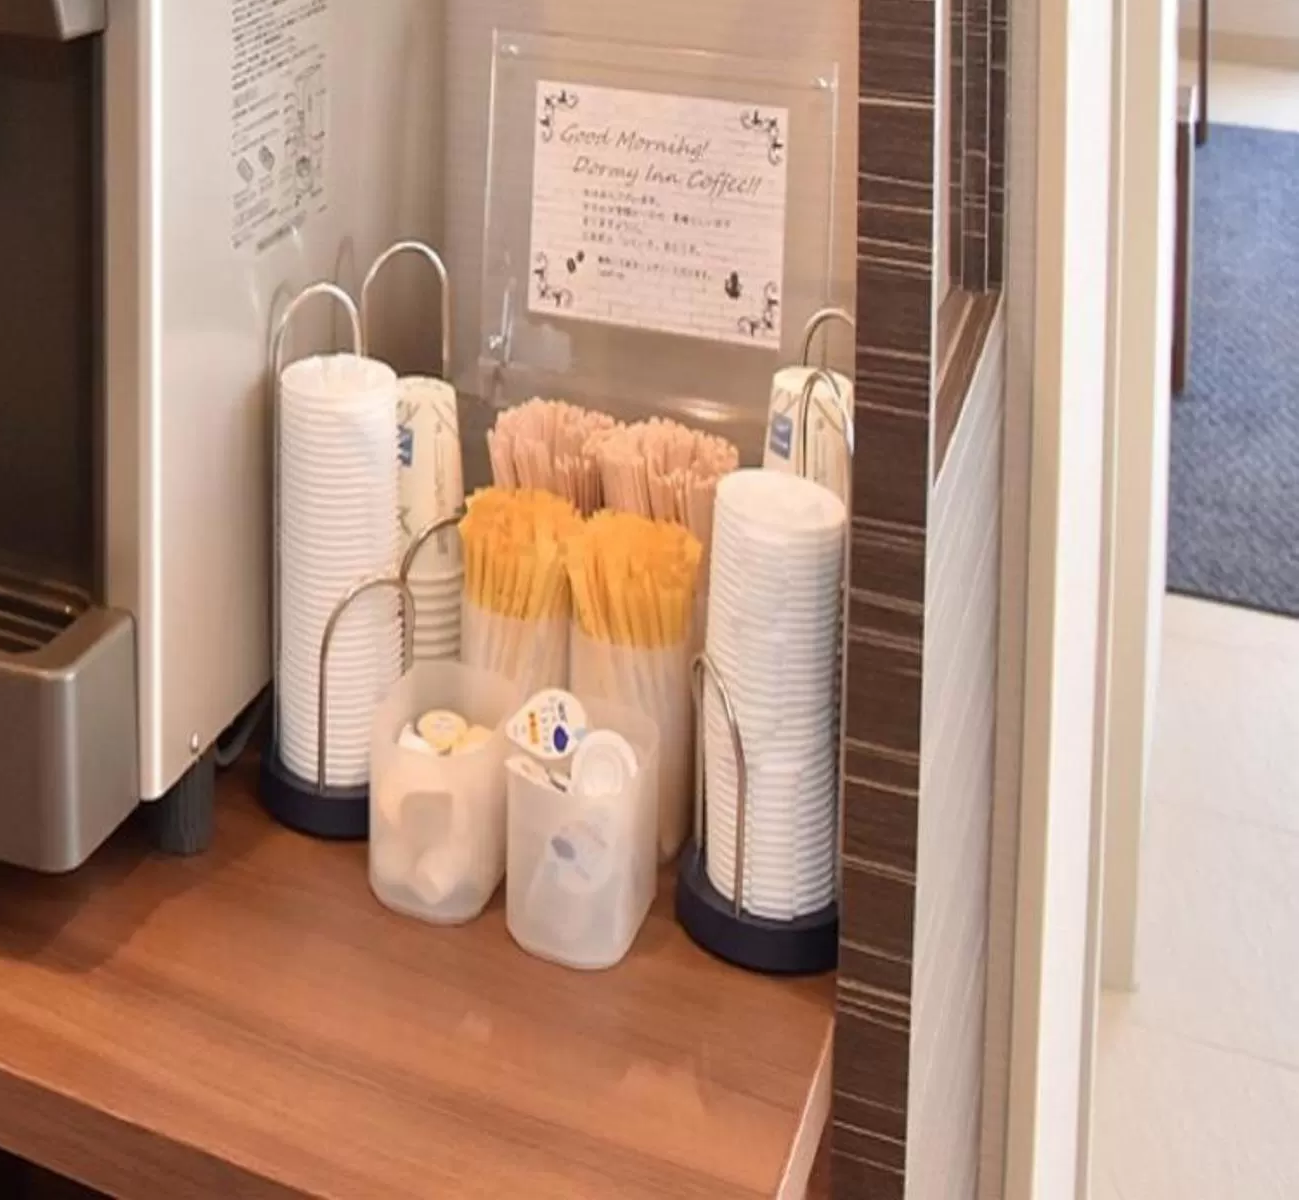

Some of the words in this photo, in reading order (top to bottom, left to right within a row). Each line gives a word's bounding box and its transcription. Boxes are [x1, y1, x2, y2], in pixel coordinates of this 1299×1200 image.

[559, 122, 611, 147] Good
[615, 130, 712, 163] Morning!
[572, 155, 640, 187] Dormy
[645, 163, 679, 184] Inn
